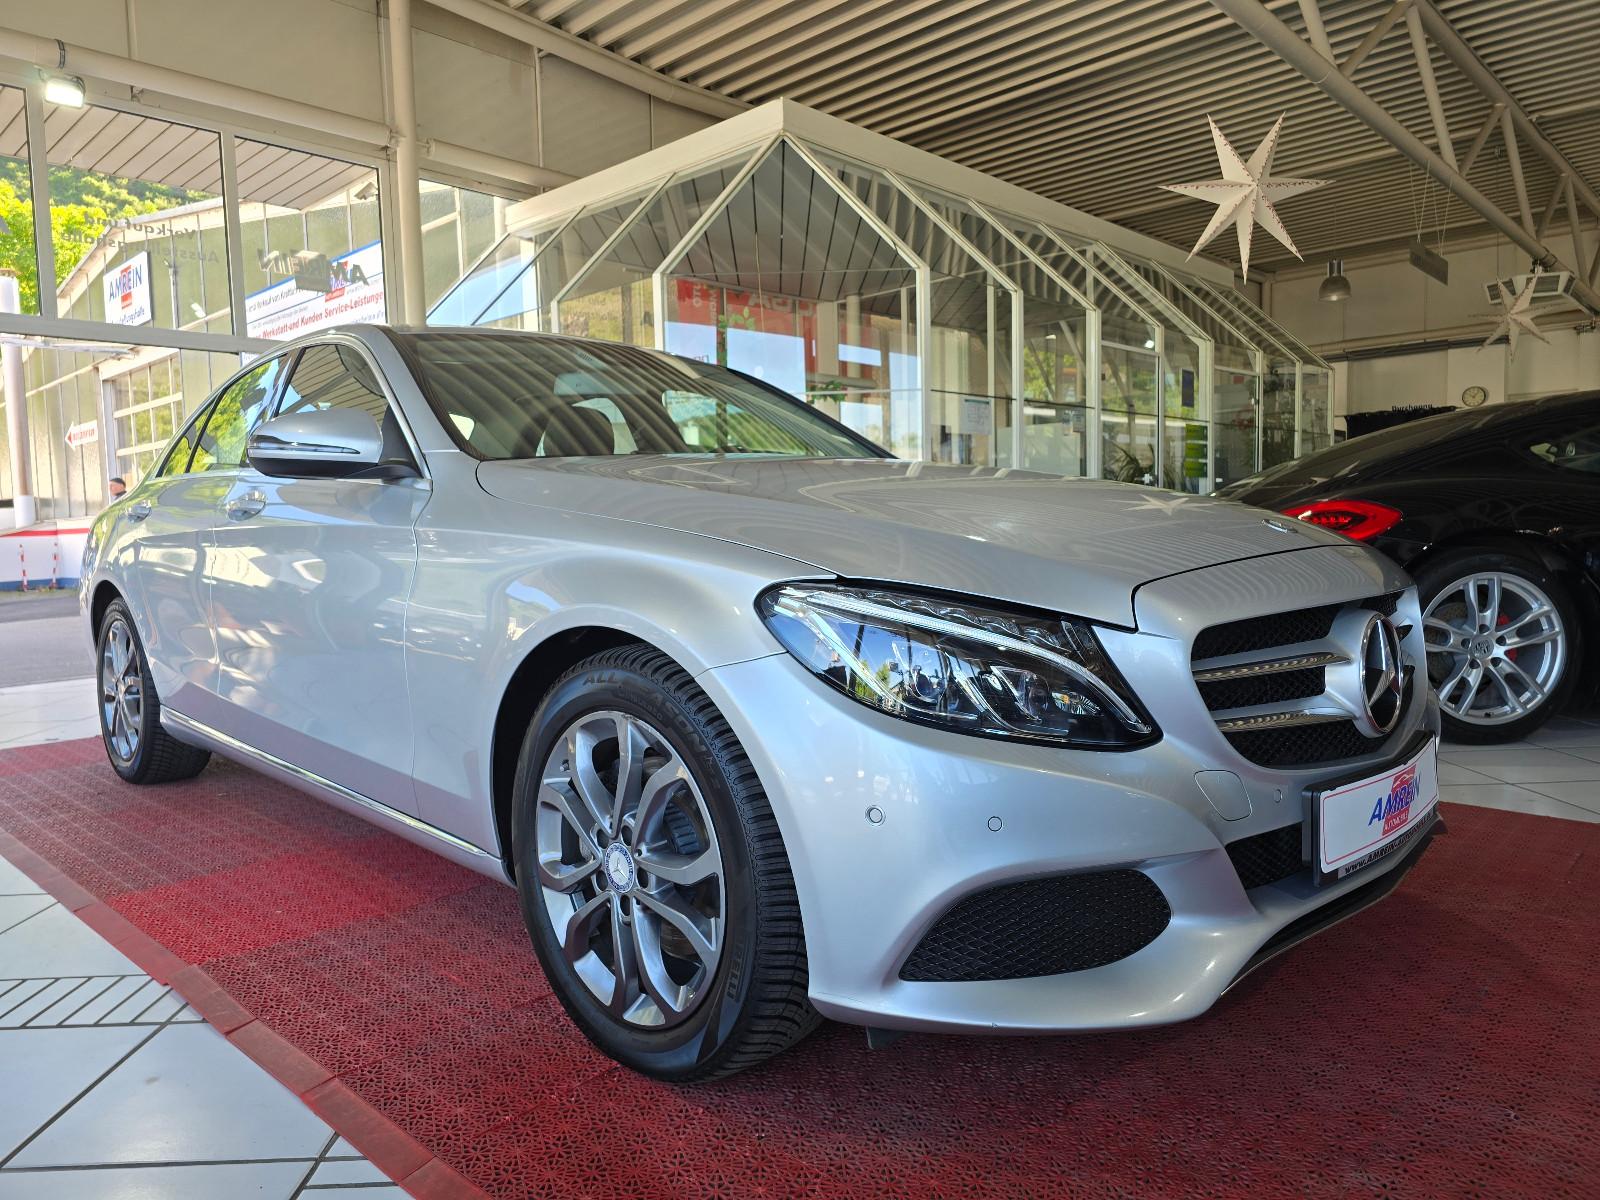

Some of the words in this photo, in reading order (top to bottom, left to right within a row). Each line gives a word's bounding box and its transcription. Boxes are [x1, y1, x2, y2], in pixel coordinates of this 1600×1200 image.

[109, 263, 142, 302] AMREIN
[301, 312, 323, 326] Kunden
[1368, 773, 1421, 827] AMREIN
